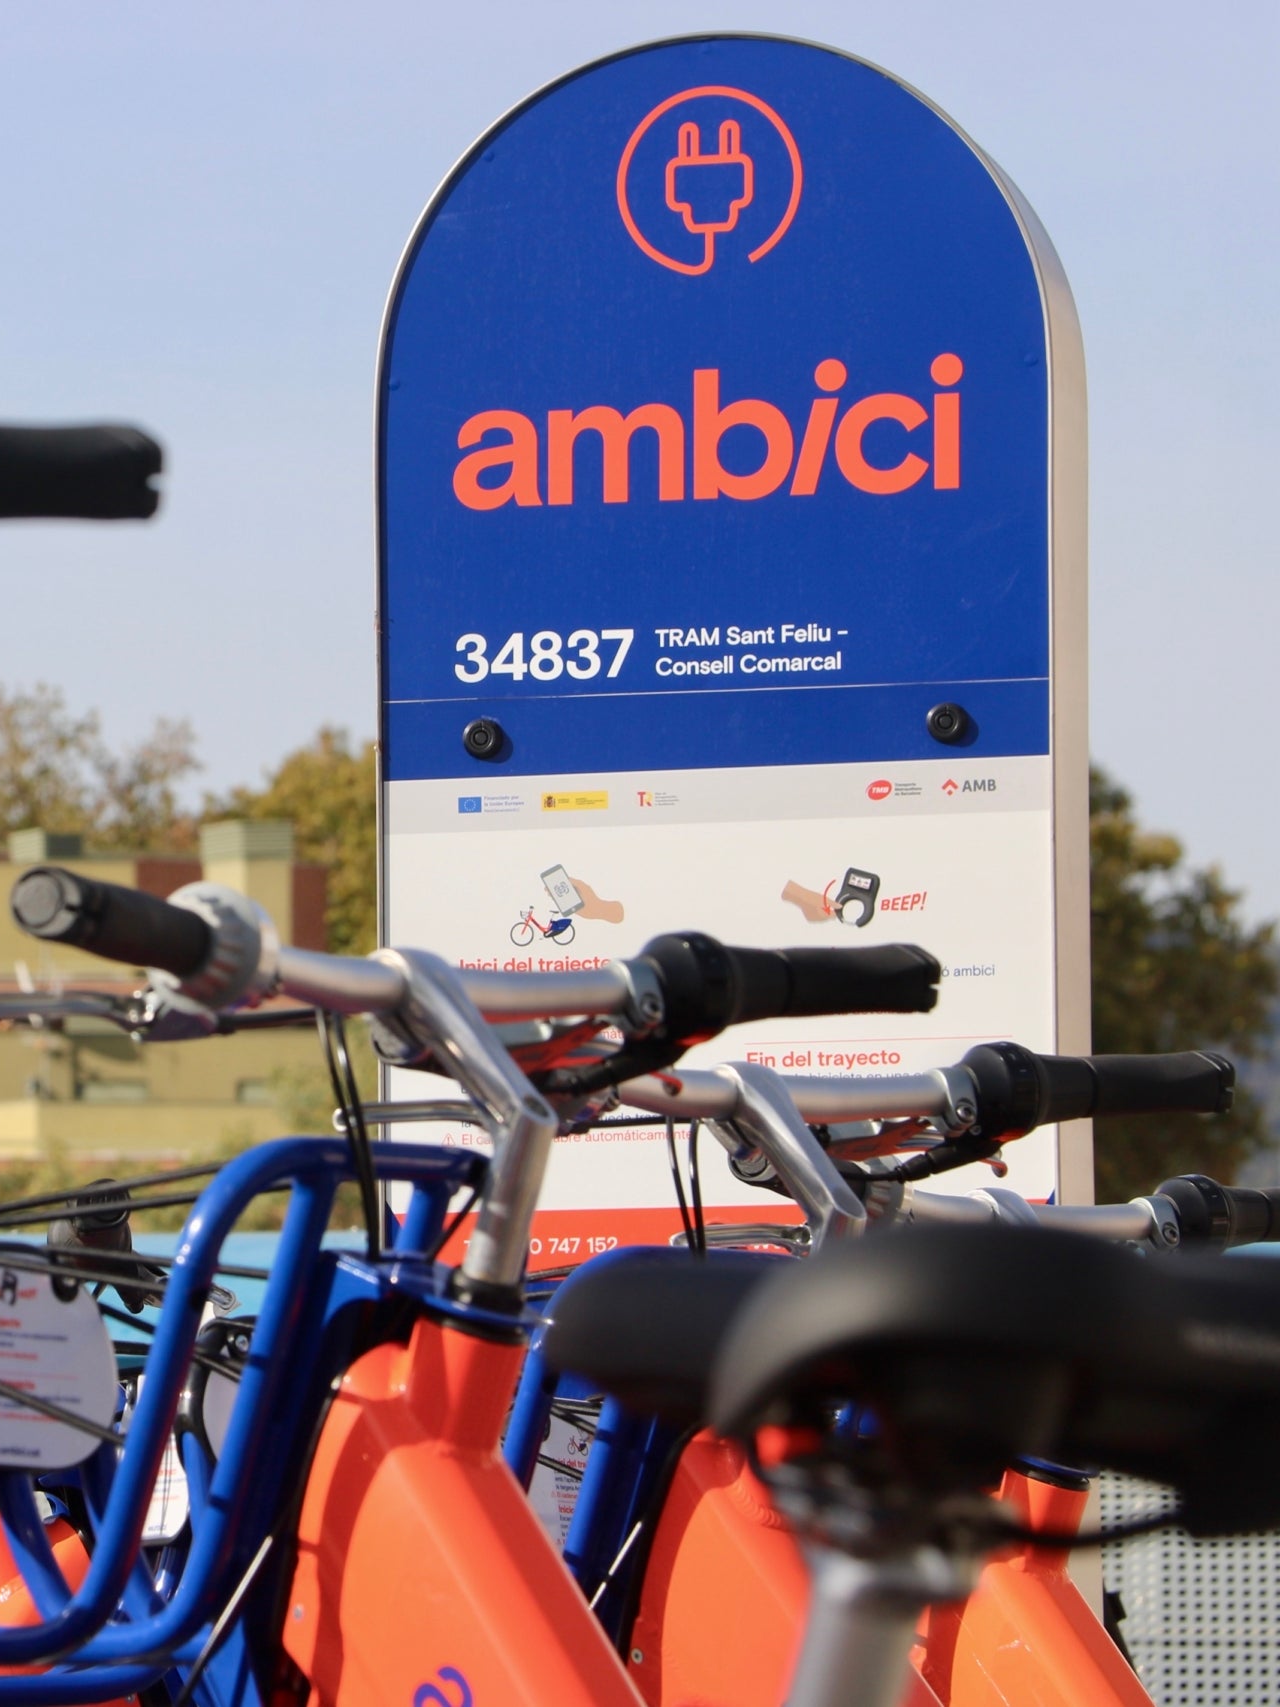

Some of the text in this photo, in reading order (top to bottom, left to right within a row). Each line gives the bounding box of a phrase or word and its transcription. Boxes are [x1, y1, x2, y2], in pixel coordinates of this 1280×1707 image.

[453, 353, 964, 511] ambici
[654, 627, 720, 648] TRAM
[726, 625, 775, 646] Sant
[781, 623, 832, 644] Feliu
[454, 628, 635, 684] 34837
[655, 650, 842, 677] Consell Comarcal
[962, 778, 997, 792] AMB
[880, 891, 927, 911] BEEP!
[503, 957, 533, 973] del
[953, 964, 995, 977] ambici
[746, 1049, 902, 1071] Fin del trayecto
[461, 1134, 473, 1145] El
[547, 1237, 580, 1255] 747
[586, 1236, 618, 1253] 152
